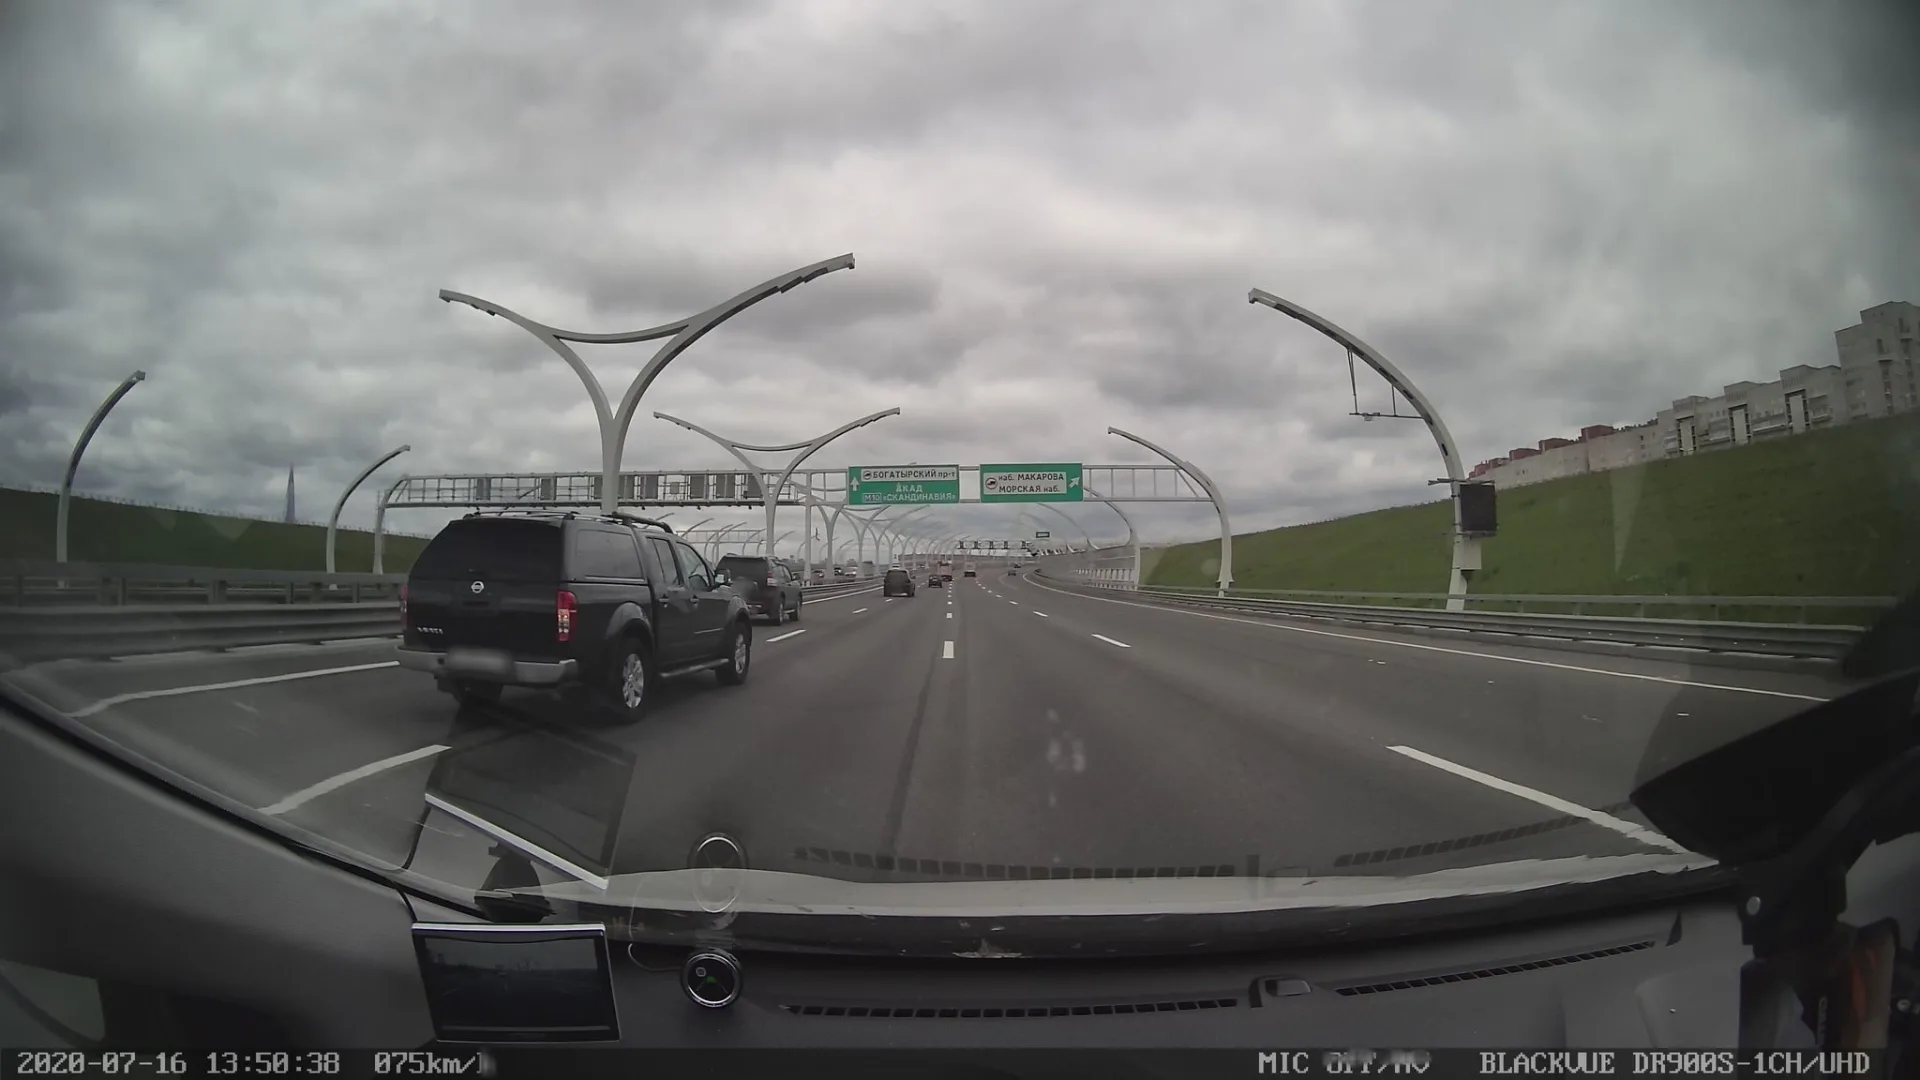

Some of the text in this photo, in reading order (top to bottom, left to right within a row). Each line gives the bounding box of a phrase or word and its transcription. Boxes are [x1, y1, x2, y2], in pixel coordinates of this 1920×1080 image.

[872, 469, 955, 479] БОГАТЫРСКИЙ пр-т
[1017, 473, 1064, 481] МАКАРОВА
[998, 485, 1061, 493] МОРСКАЯ наб.
